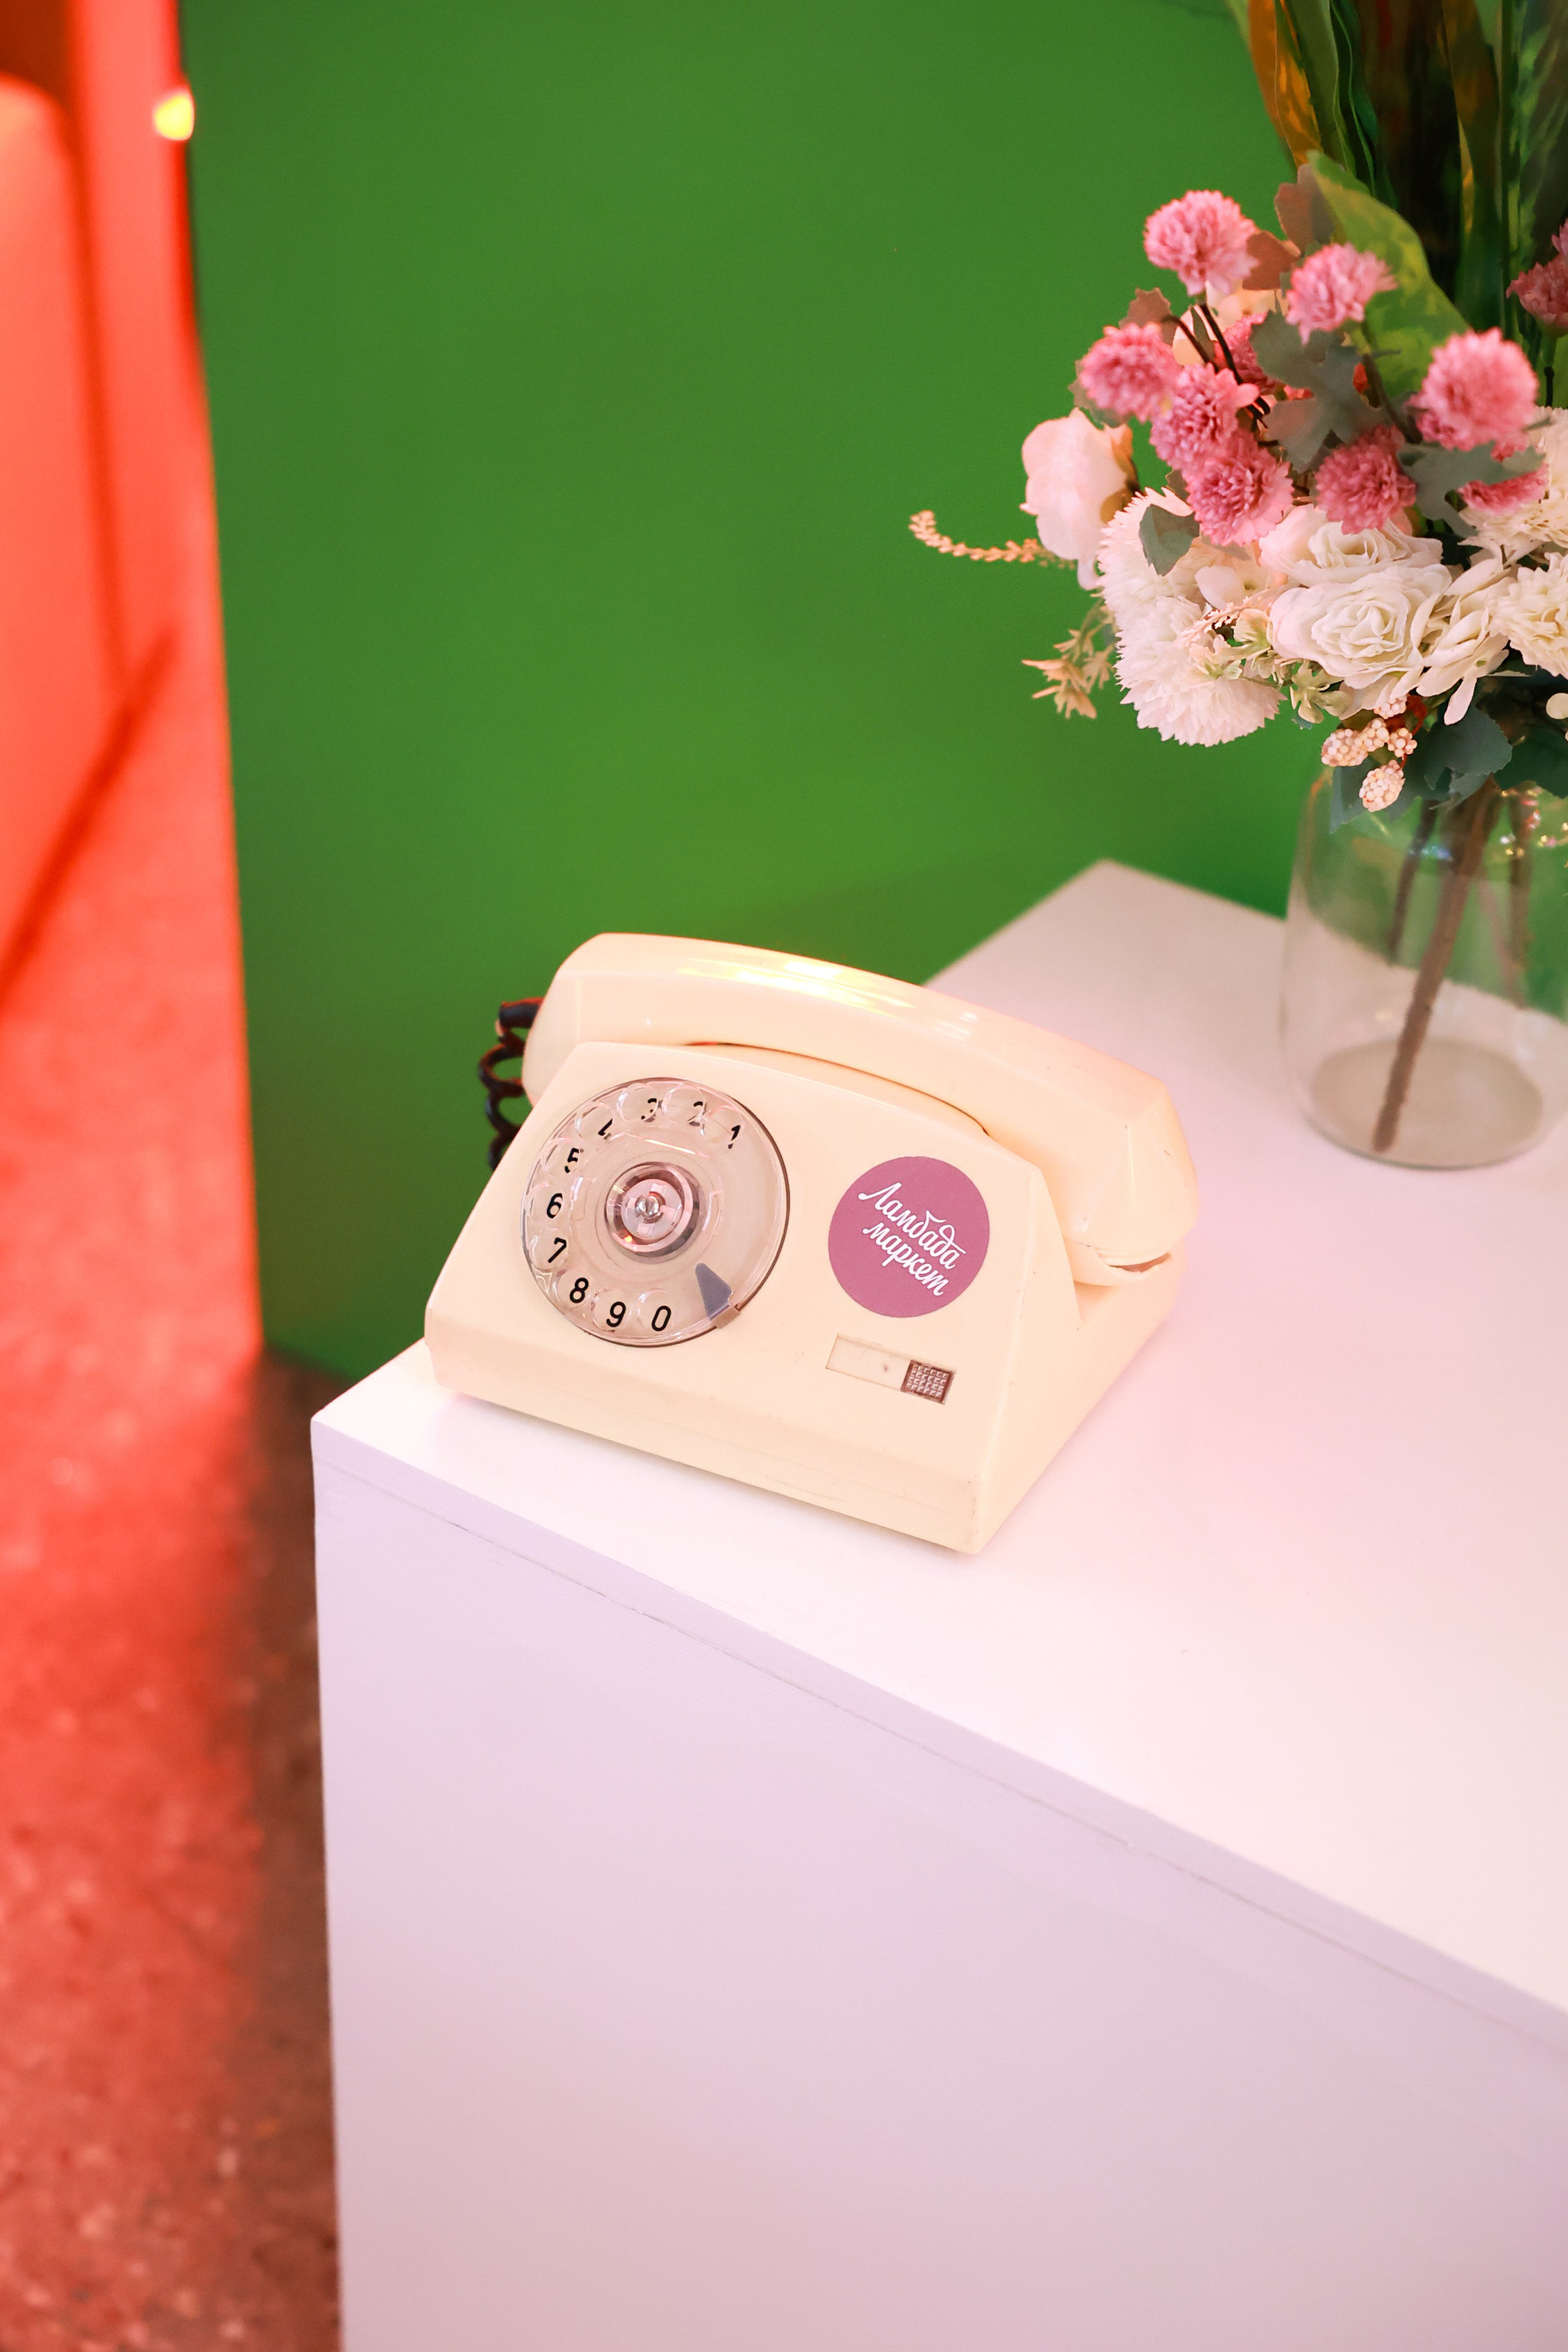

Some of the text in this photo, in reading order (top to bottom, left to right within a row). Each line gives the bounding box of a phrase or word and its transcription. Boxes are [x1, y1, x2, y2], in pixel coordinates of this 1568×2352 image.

[728, 1125, 741, 1149] 1
[564, 1147, 584, 1174] 5
[546, 1193, 564, 1219] 6
[858, 1182, 967, 1270] Ламбада
[548, 1237, 567, 1264] 7
[862, 1222, 949, 1296] маркет
[570, 1277, 589, 1303] 8
[606, 1301, 627, 1327] 9
[651, 1305, 672, 1332] 0
